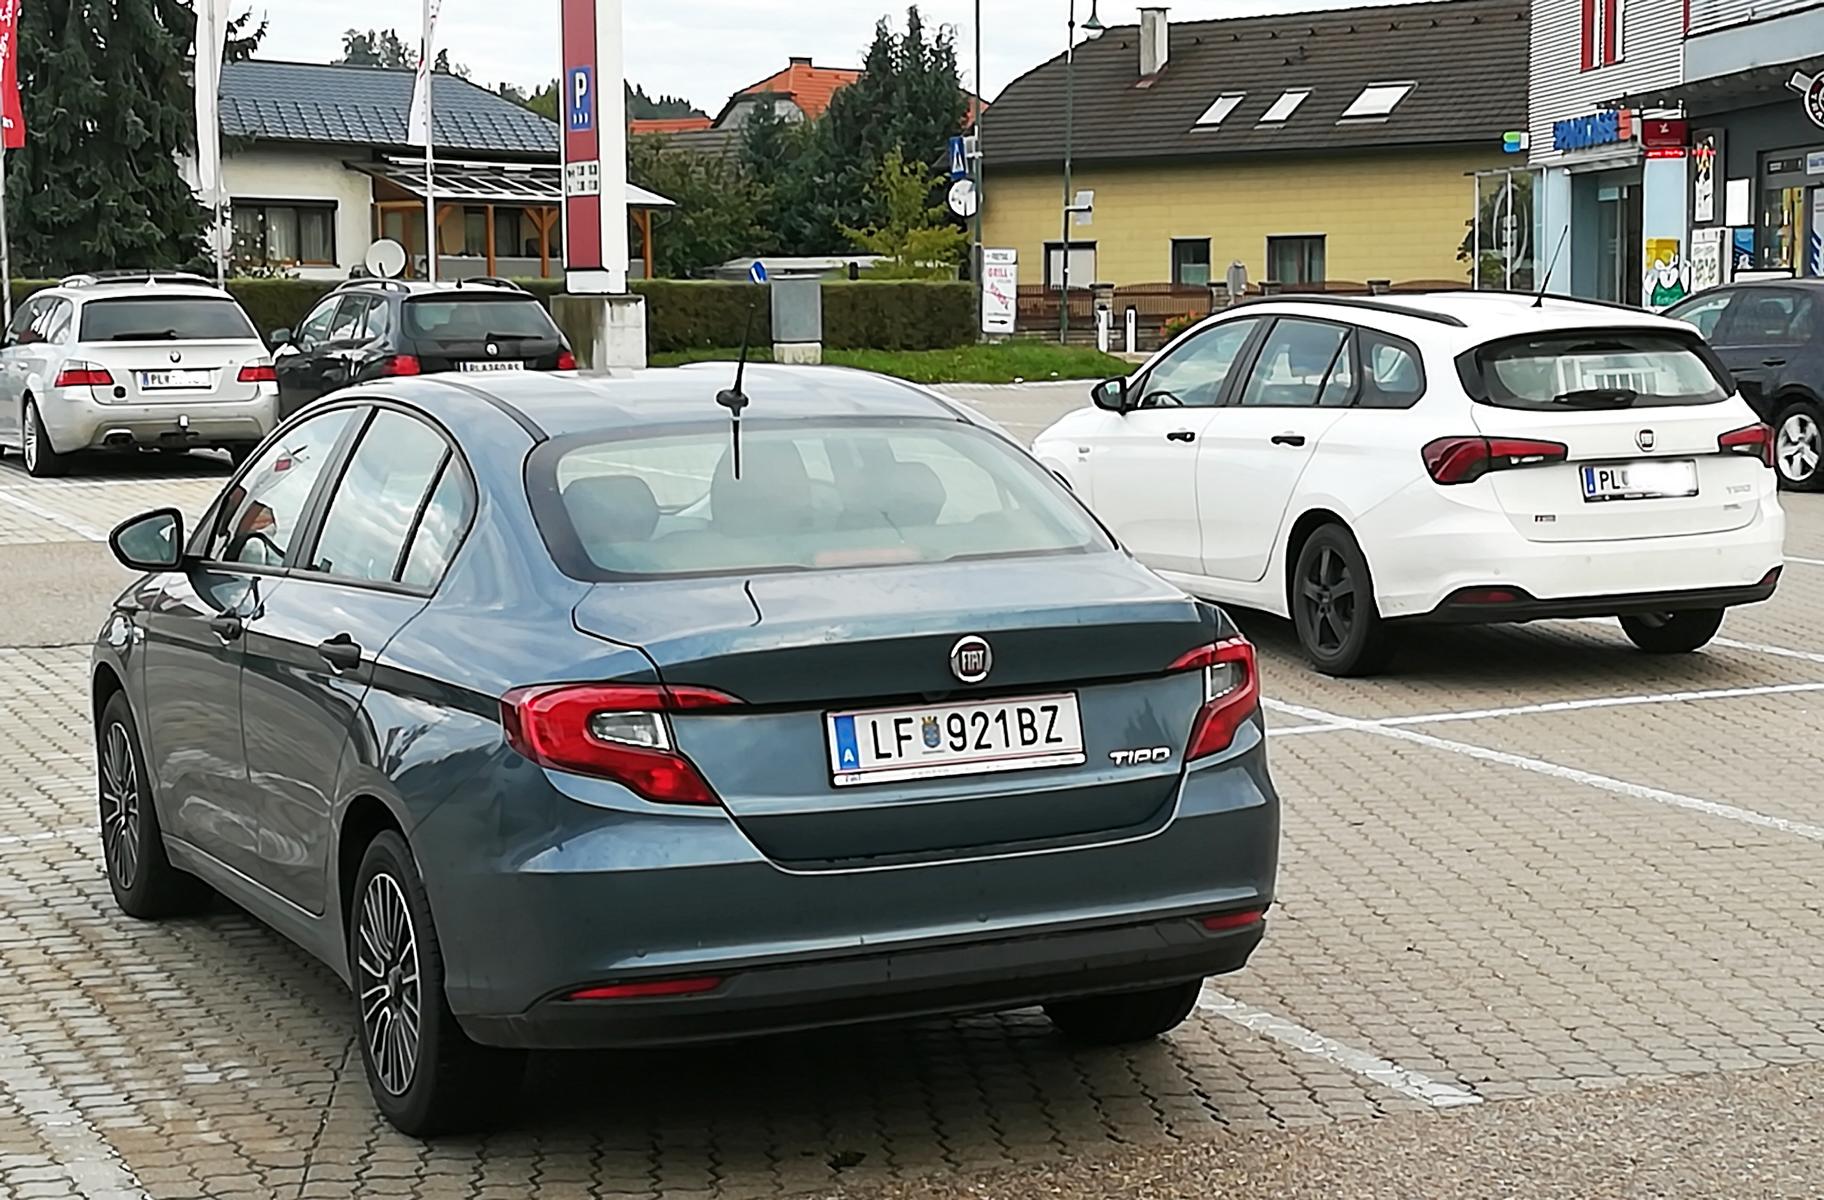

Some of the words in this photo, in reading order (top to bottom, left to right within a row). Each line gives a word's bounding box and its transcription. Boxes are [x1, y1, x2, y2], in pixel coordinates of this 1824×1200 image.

[575, 71, 588, 109] P
[988, 267, 1007, 277] GRILL
[1599, 470, 1620, 490] PL
[961, 650, 984, 671] FIAT
[871, 716, 913, 760] LF
[946, 704, 1063, 752] 921BZ
[843, 749, 855, 763] A
[1109, 747, 1171, 766] TIPO
